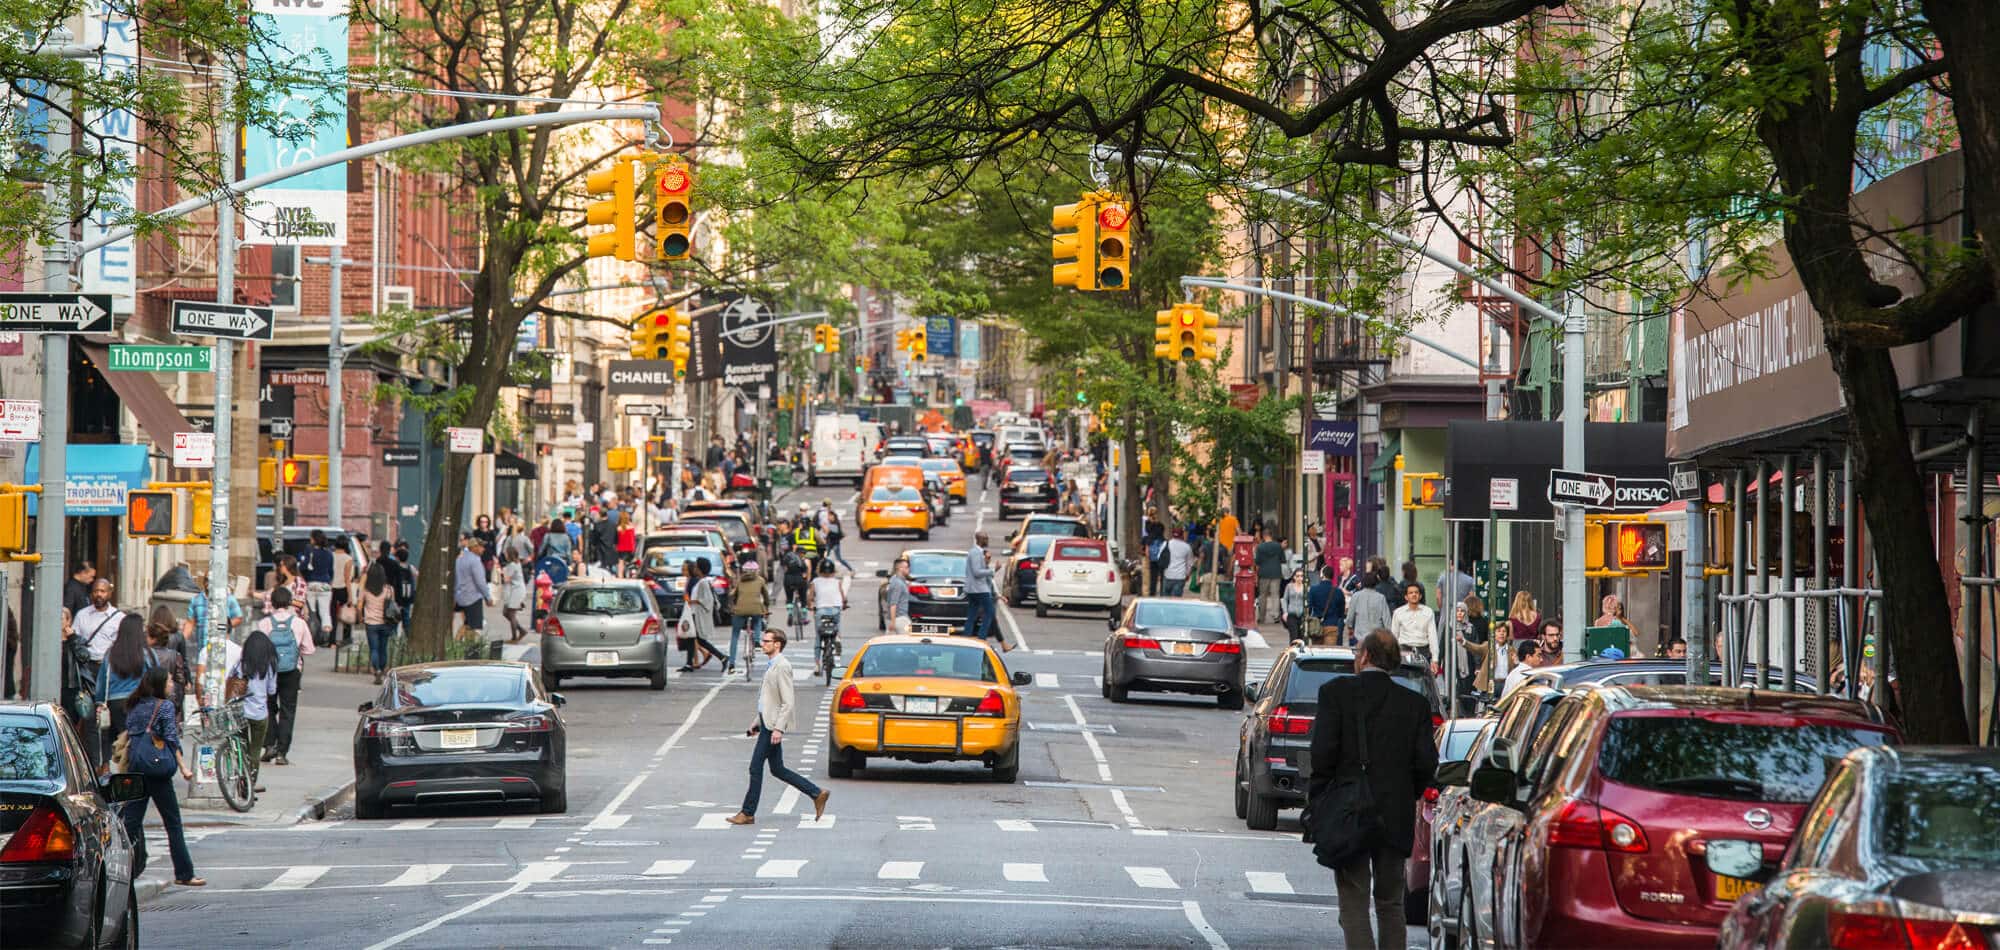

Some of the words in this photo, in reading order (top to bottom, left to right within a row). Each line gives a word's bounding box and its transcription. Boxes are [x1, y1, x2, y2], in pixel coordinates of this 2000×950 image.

[7, 305, 42, 320] ONE
[58, 305, 94, 320] WAY
[187, 312, 216, 326] ONE
[229, 315, 257, 329] WAY
[1736, 311, 1761, 385] STAND
[1763, 298, 1791, 375] ALONE
[113, 347, 193, 371] Thompson
[200, 350, 209, 362] St
[611, 371, 671, 383] CHANEL
[724, 363, 774, 376] American
[282, 373, 325, 385] Broadway
[724, 371, 766, 385] Apparel
[1312, 427, 1355, 448] jeremy
[1561, 480, 1581, 495] ONE
[1588, 483, 1607, 498] WAY
[1616, 487, 1670, 502] ORTSAC
[1640, 891, 1685, 903] ROGUE
